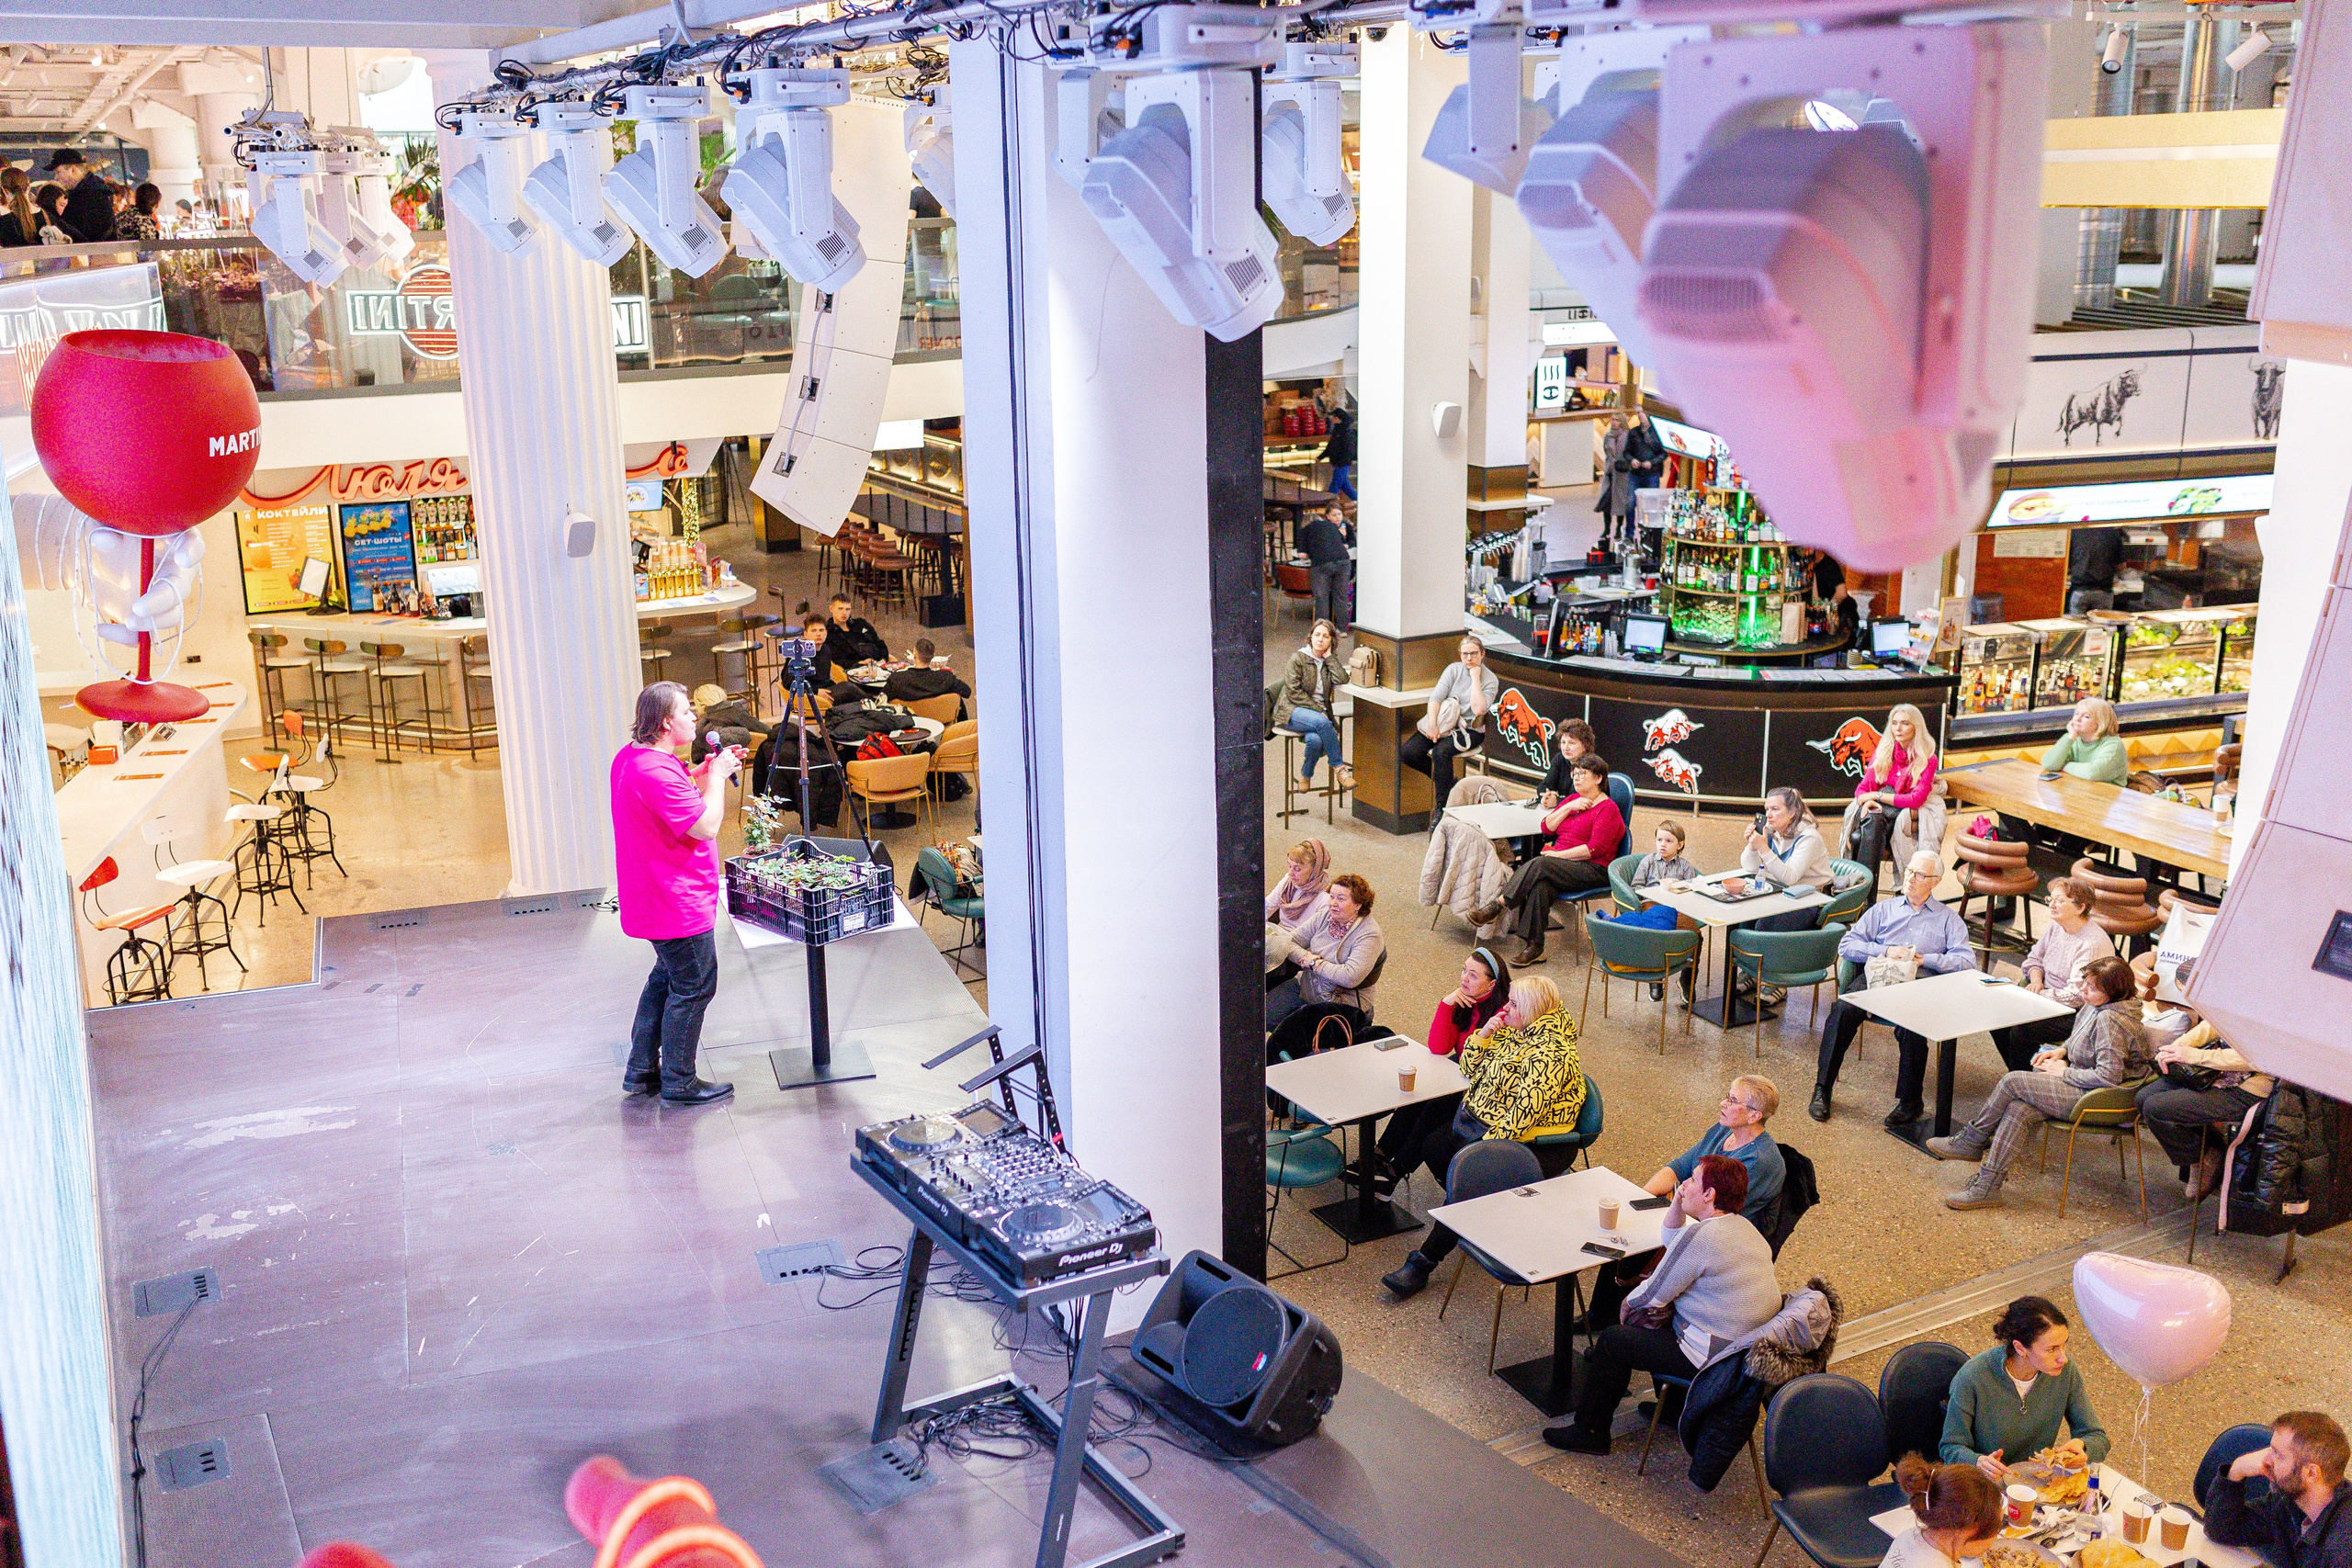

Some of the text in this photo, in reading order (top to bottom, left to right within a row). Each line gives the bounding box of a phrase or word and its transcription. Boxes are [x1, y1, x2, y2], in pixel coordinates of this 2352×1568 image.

[209, 425, 262, 457] MARTI
[256, 505, 328, 520] КОКТЕЙЛИ
[2160, 951, 2190, 962] АМИН
[1058, 1247, 1108, 1267] Pioneer
